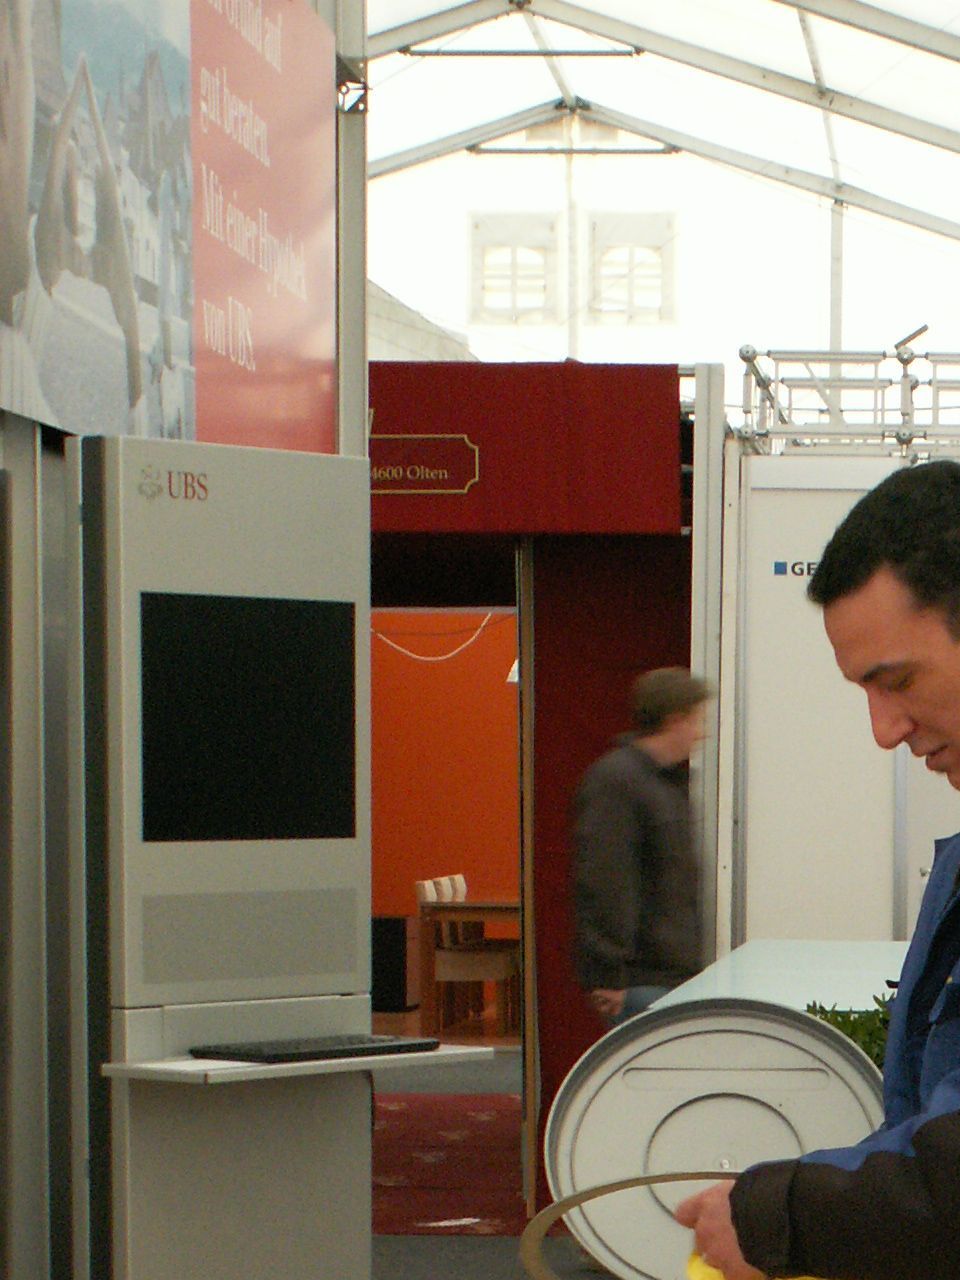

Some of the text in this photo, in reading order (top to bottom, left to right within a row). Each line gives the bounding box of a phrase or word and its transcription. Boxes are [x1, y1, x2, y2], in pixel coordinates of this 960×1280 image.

[202, 163, 226, 243] Mit
[202, 298, 227, 357] von
[167, 470, 209, 501] UBS
[371, 464, 449, 480] 4600 Olten
